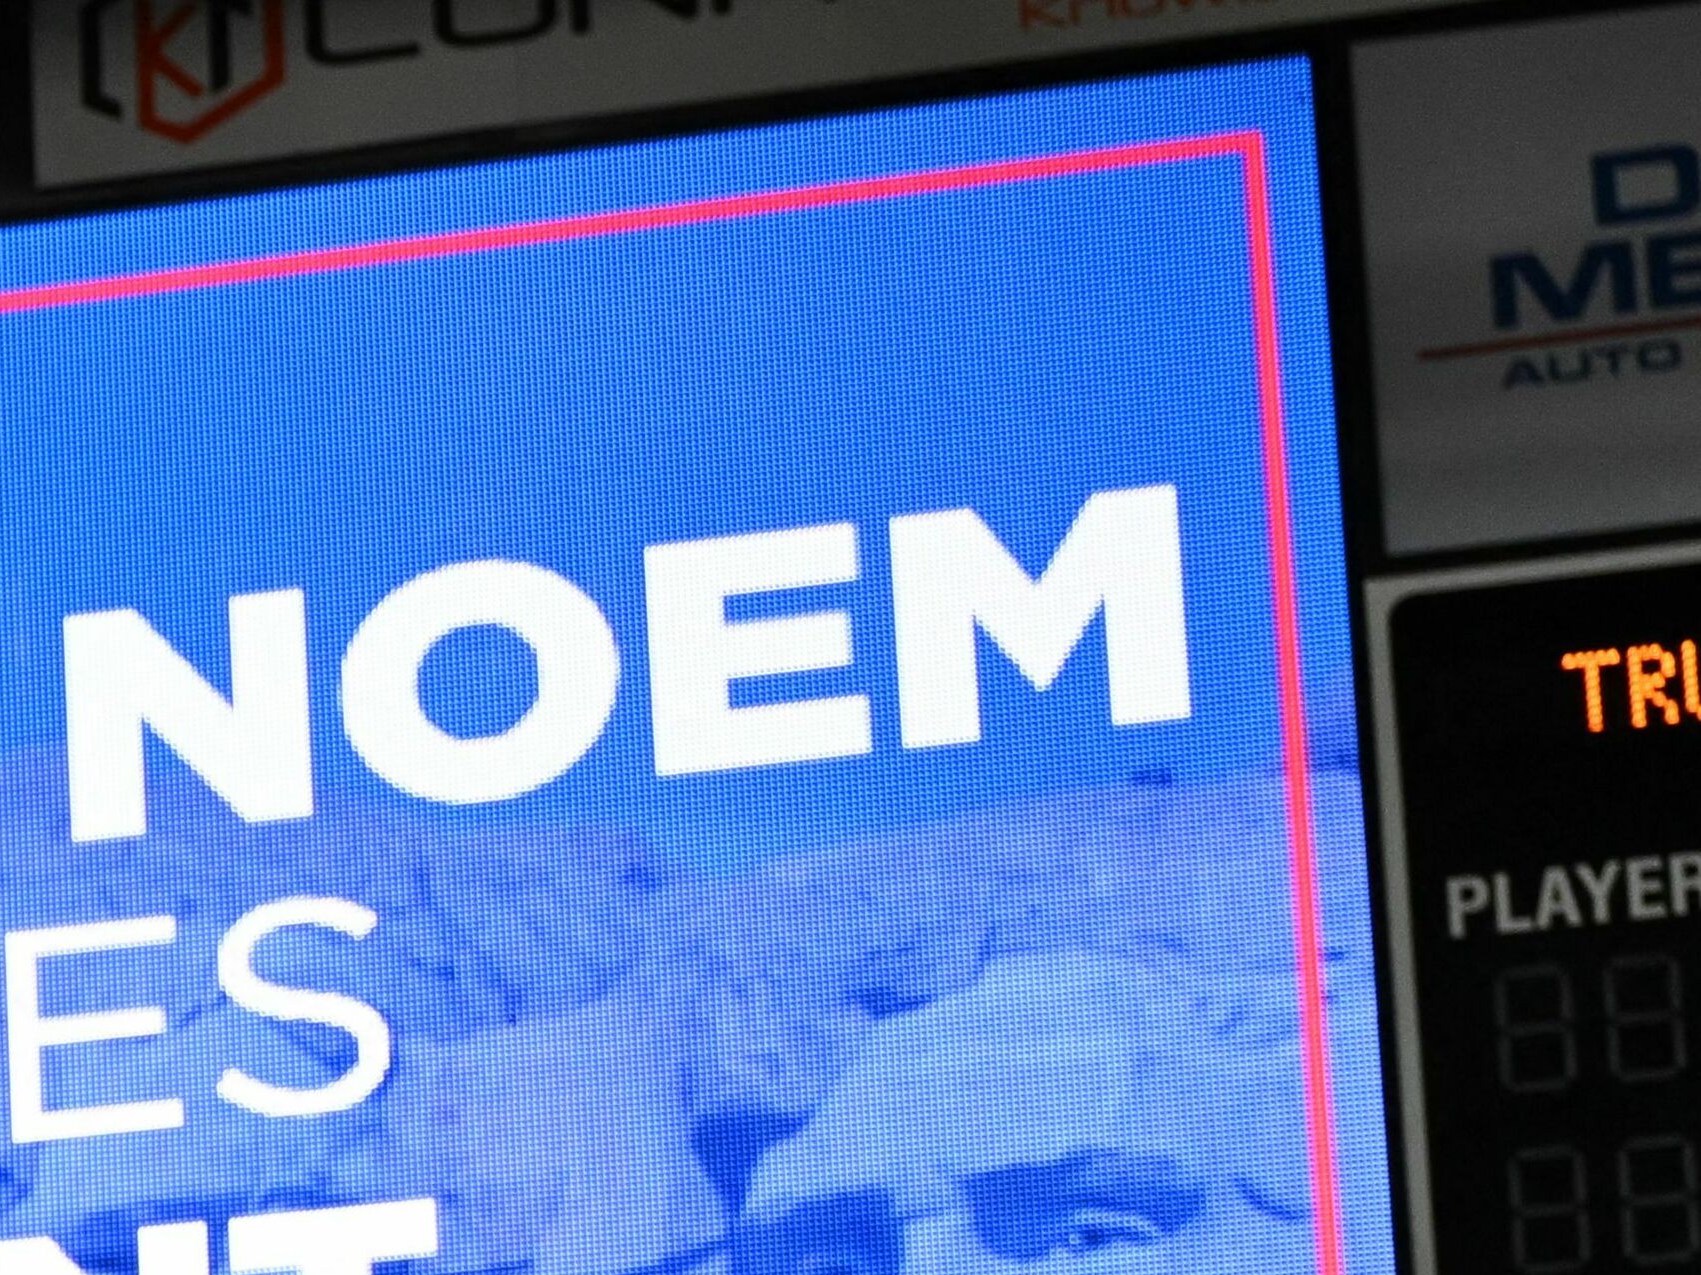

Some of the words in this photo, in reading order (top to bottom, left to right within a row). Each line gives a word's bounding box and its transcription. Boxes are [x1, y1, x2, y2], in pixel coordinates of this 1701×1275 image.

[1502, 338, 1682, 391] AUTO
[64, 486, 1190, 841] NOEM
[1445, 850, 1701, 941] PLAYER
